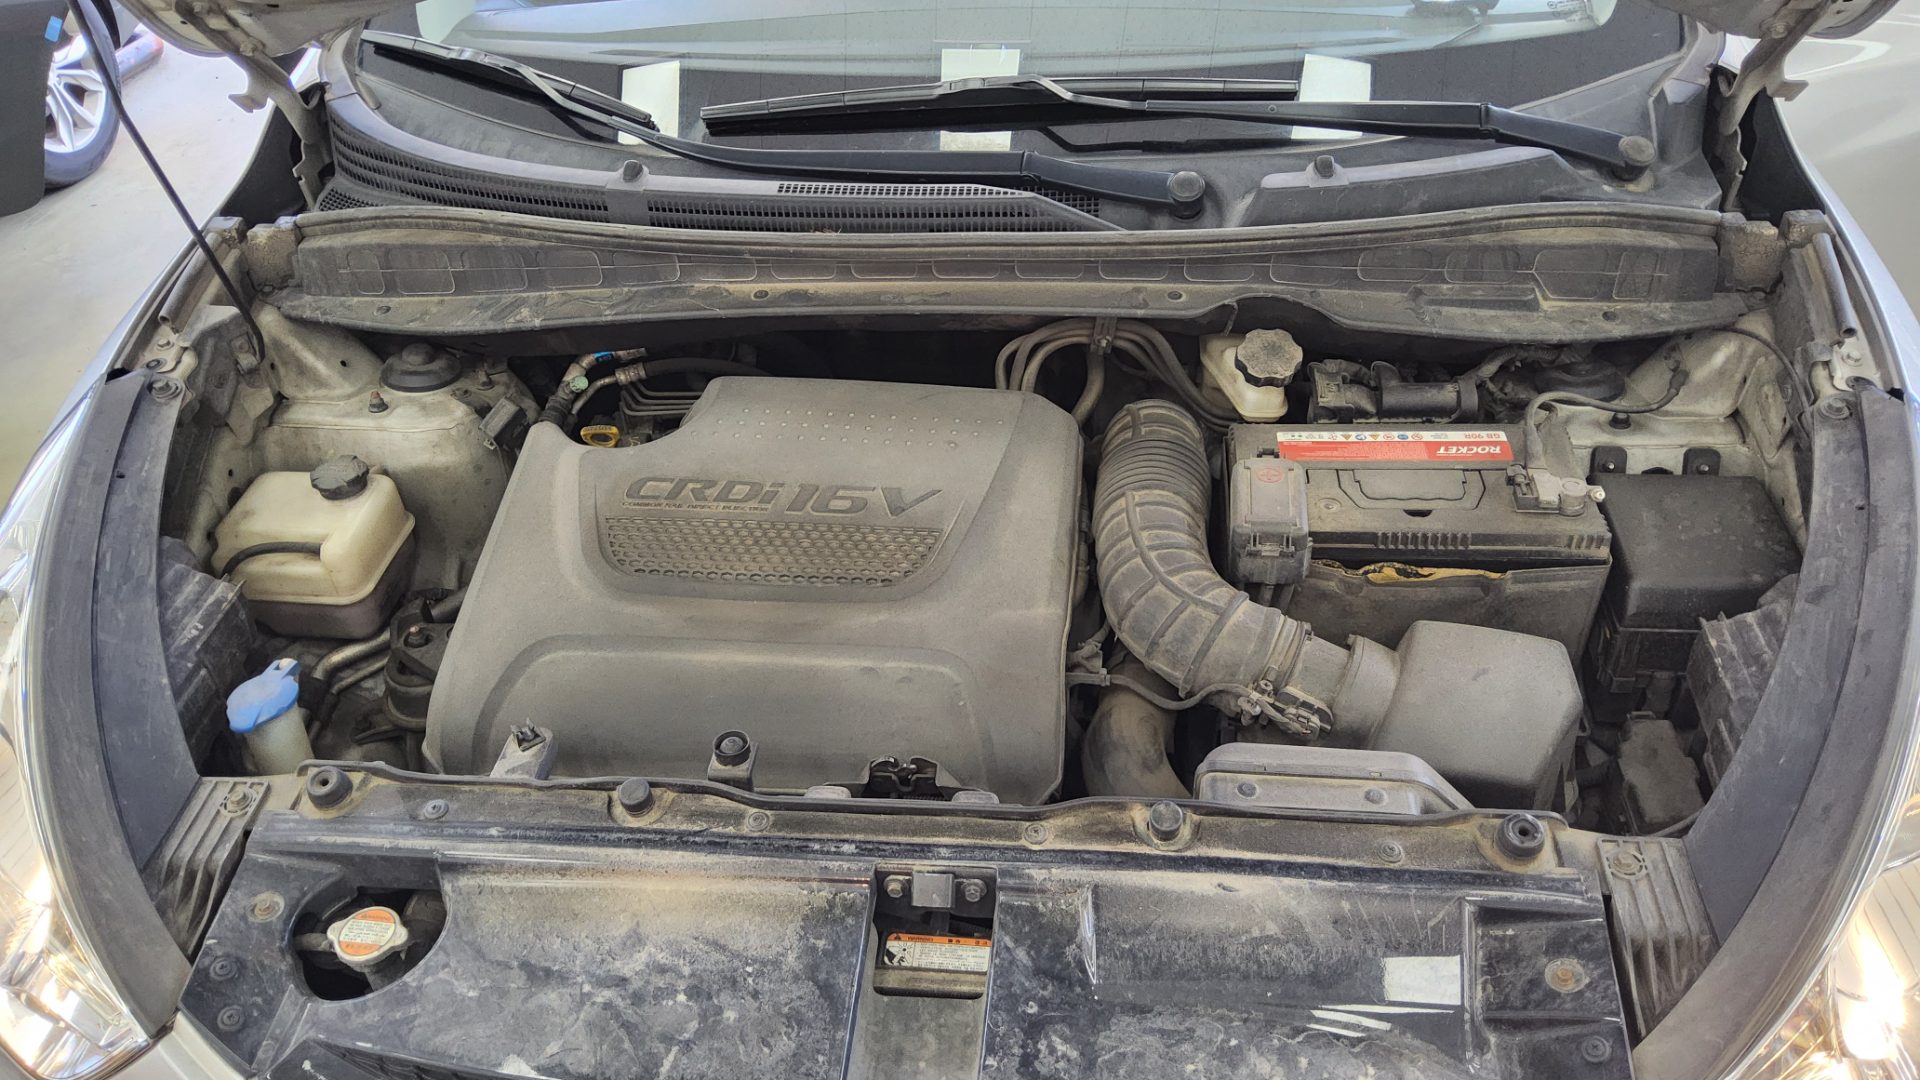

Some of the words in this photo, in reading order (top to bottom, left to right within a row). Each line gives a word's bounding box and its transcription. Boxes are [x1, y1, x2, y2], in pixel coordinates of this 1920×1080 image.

[1436, 445, 1502, 454] ROCKET
[625, 477, 786, 504] CRDi
[785, 482, 943, 518] 16V
